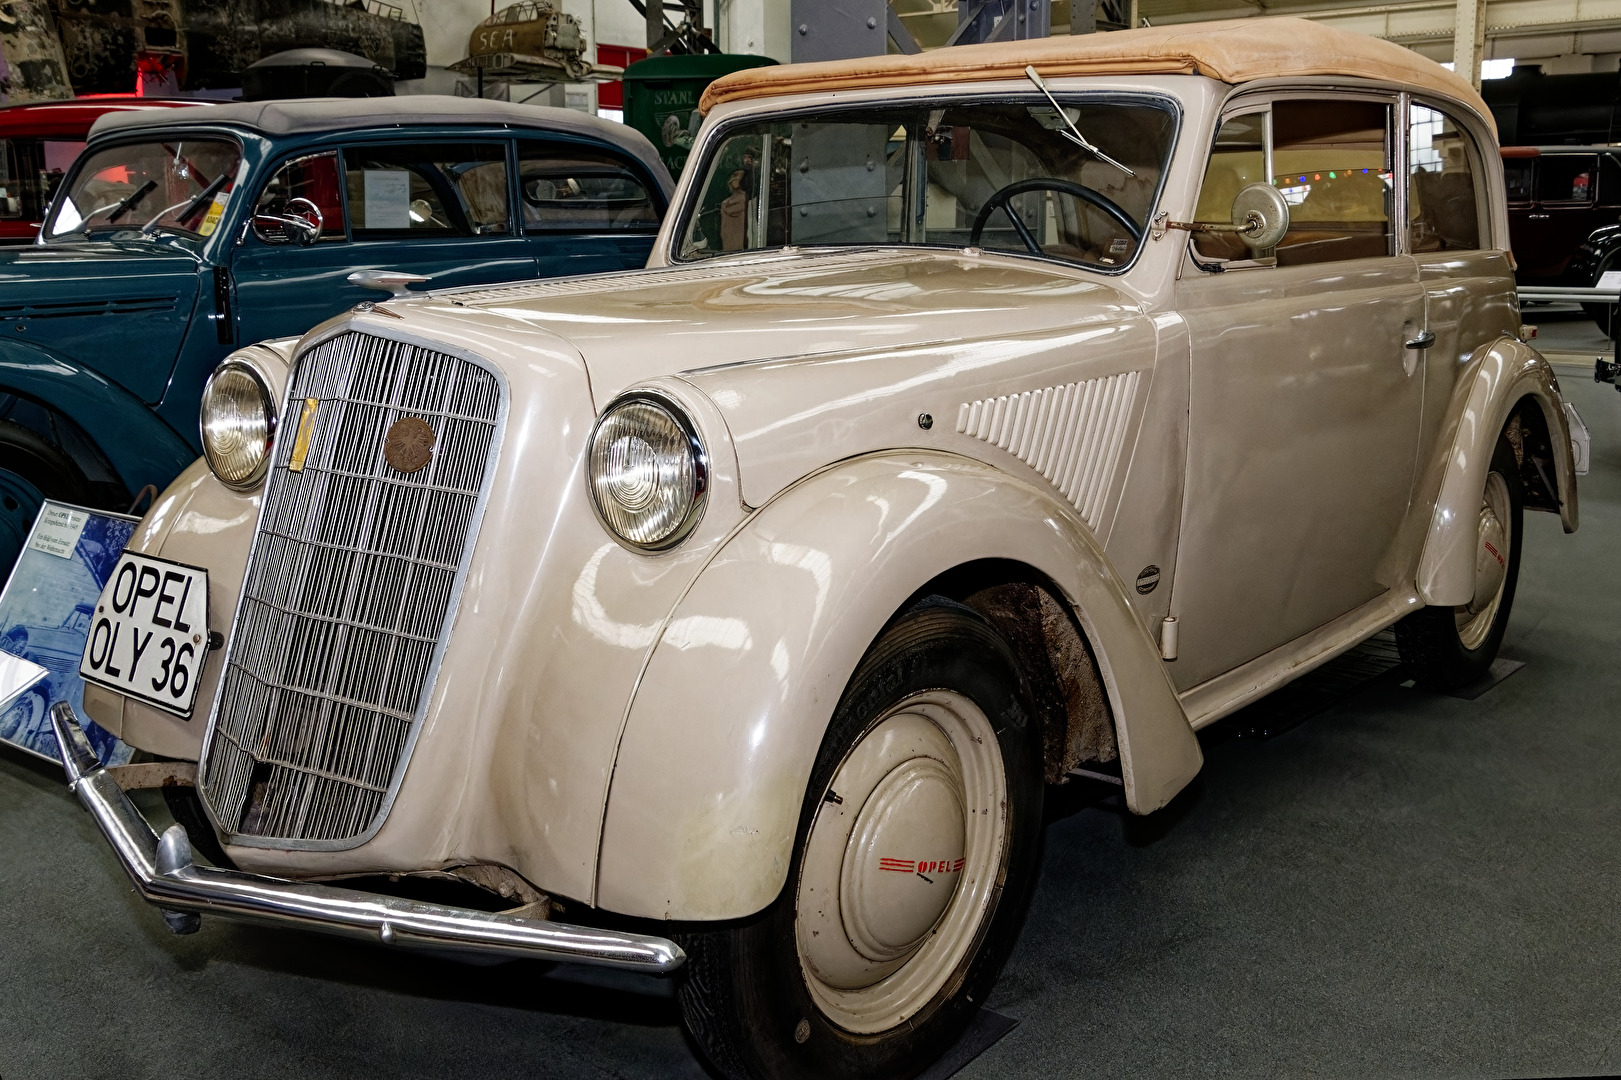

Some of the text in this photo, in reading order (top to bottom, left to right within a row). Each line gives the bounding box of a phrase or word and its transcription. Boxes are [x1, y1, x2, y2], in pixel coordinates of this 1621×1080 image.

[112, 561, 193, 634] OPEL
[89, 617, 195, 699] OLY 36
[917, 860, 951, 873] OPEL
